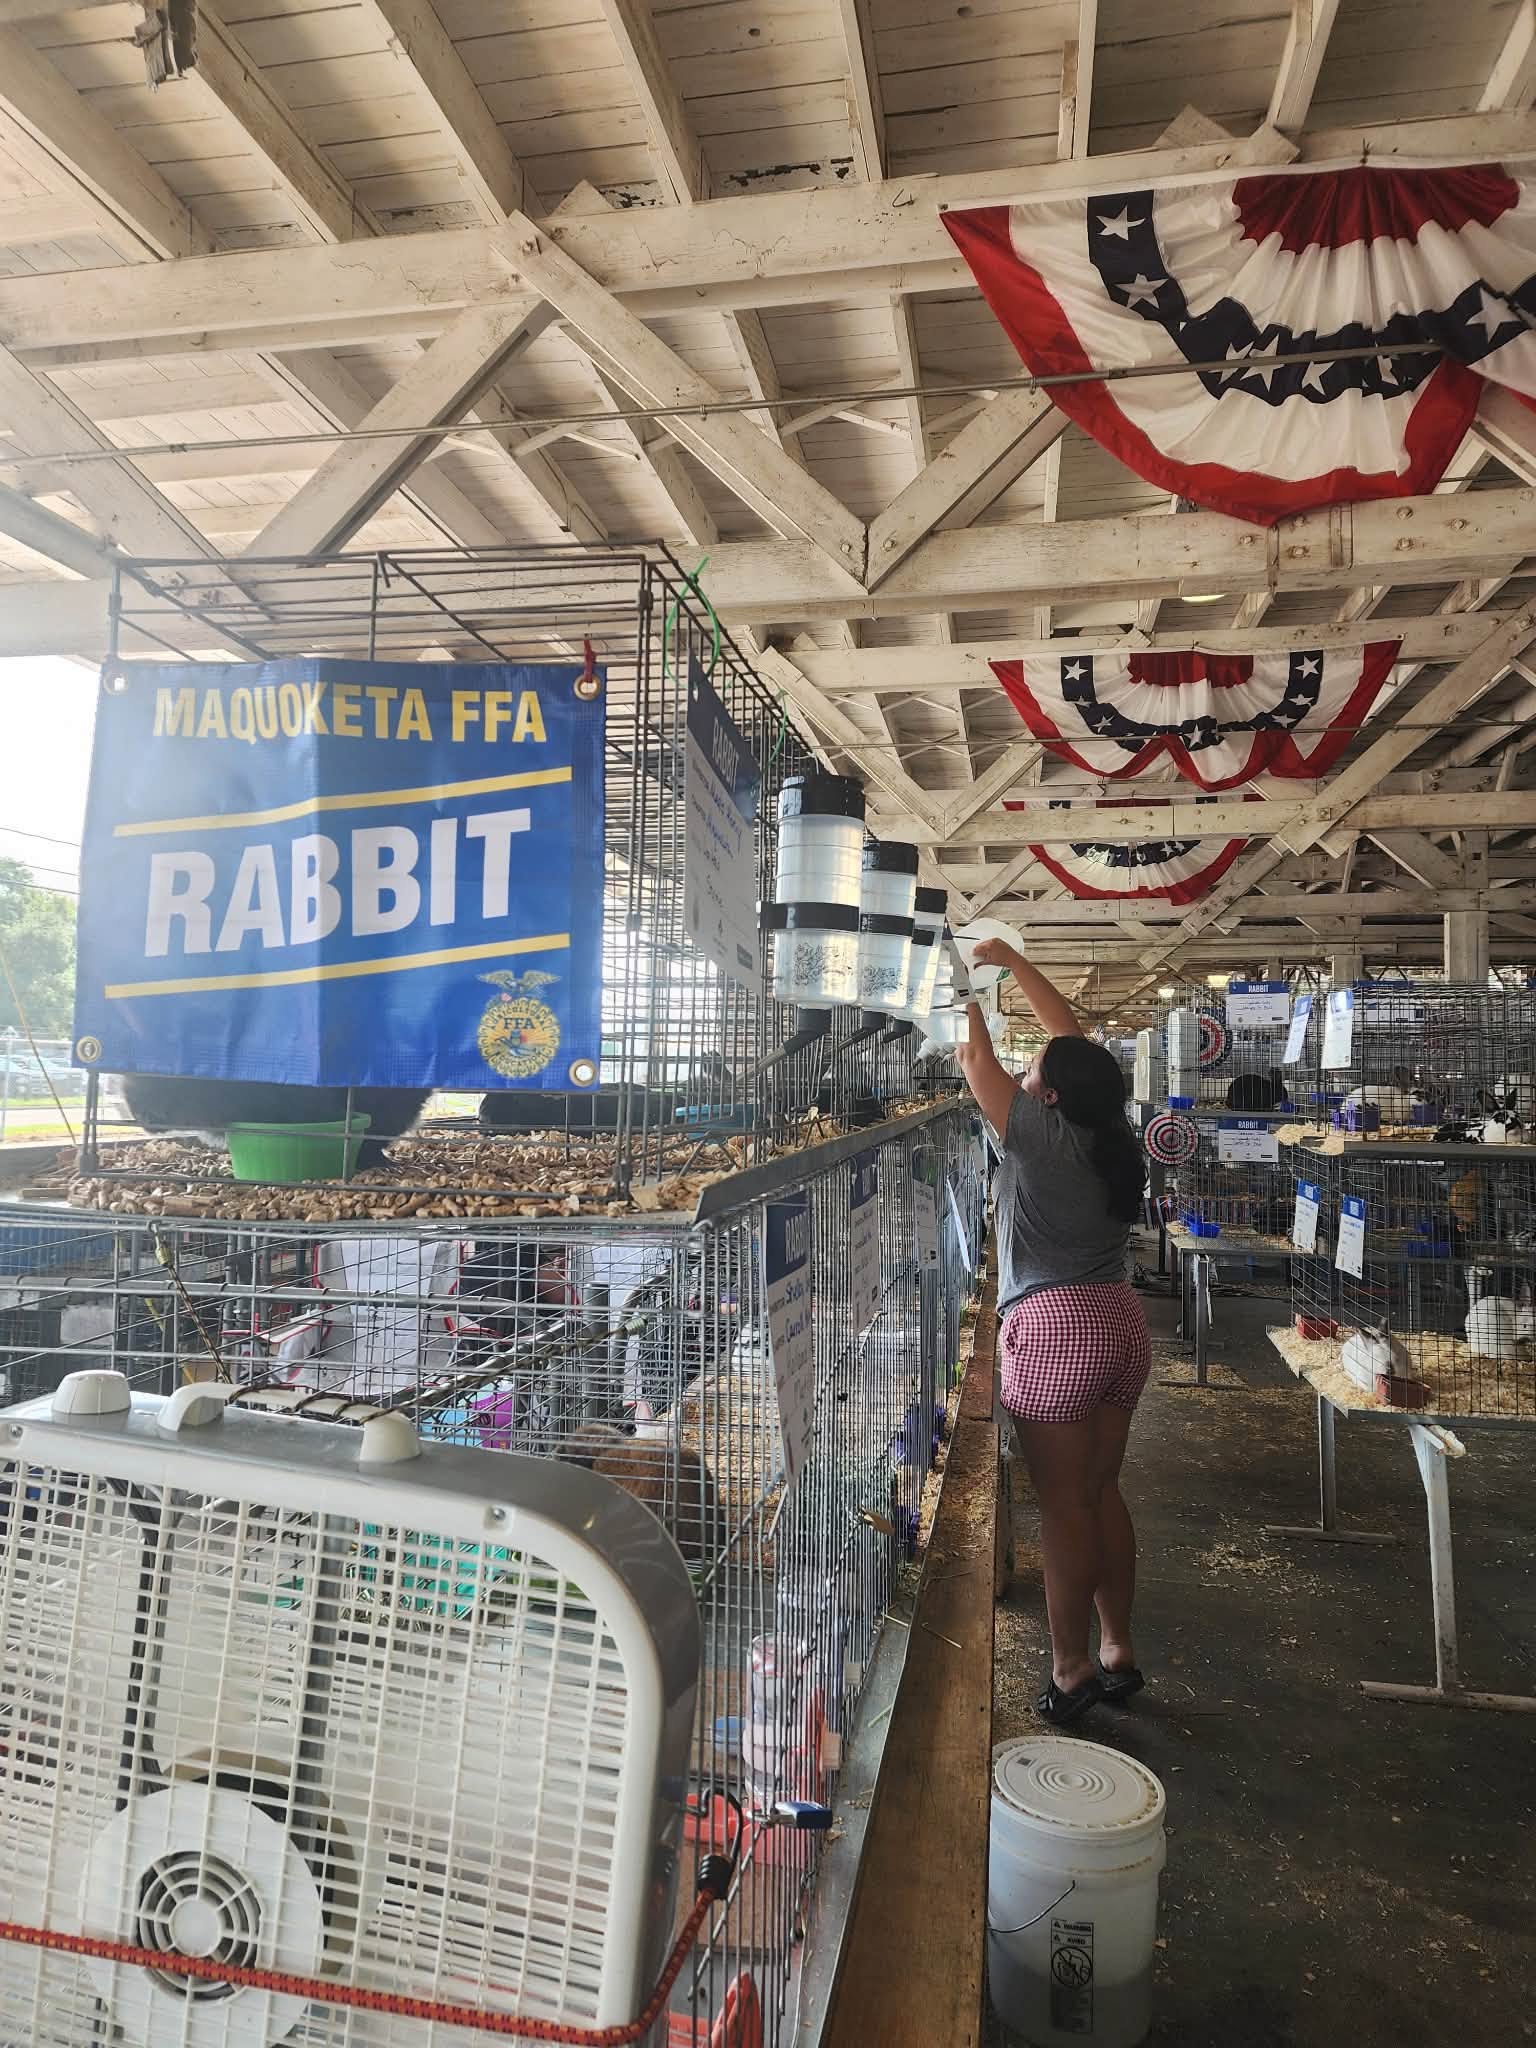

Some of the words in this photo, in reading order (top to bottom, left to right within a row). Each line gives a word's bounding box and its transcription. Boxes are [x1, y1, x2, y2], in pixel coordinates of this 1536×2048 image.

[152, 680, 433, 744] MAQUOKETA
[450, 690, 548, 743] FFA
[712, 716, 740, 793] RABBIT
[144, 807, 531, 957] RABBIT
[1248, 984, 1269, 993] RABBIT
[503, 1017, 535, 1030] FFA
[1237, 1120, 1259, 1129] RABBIT
